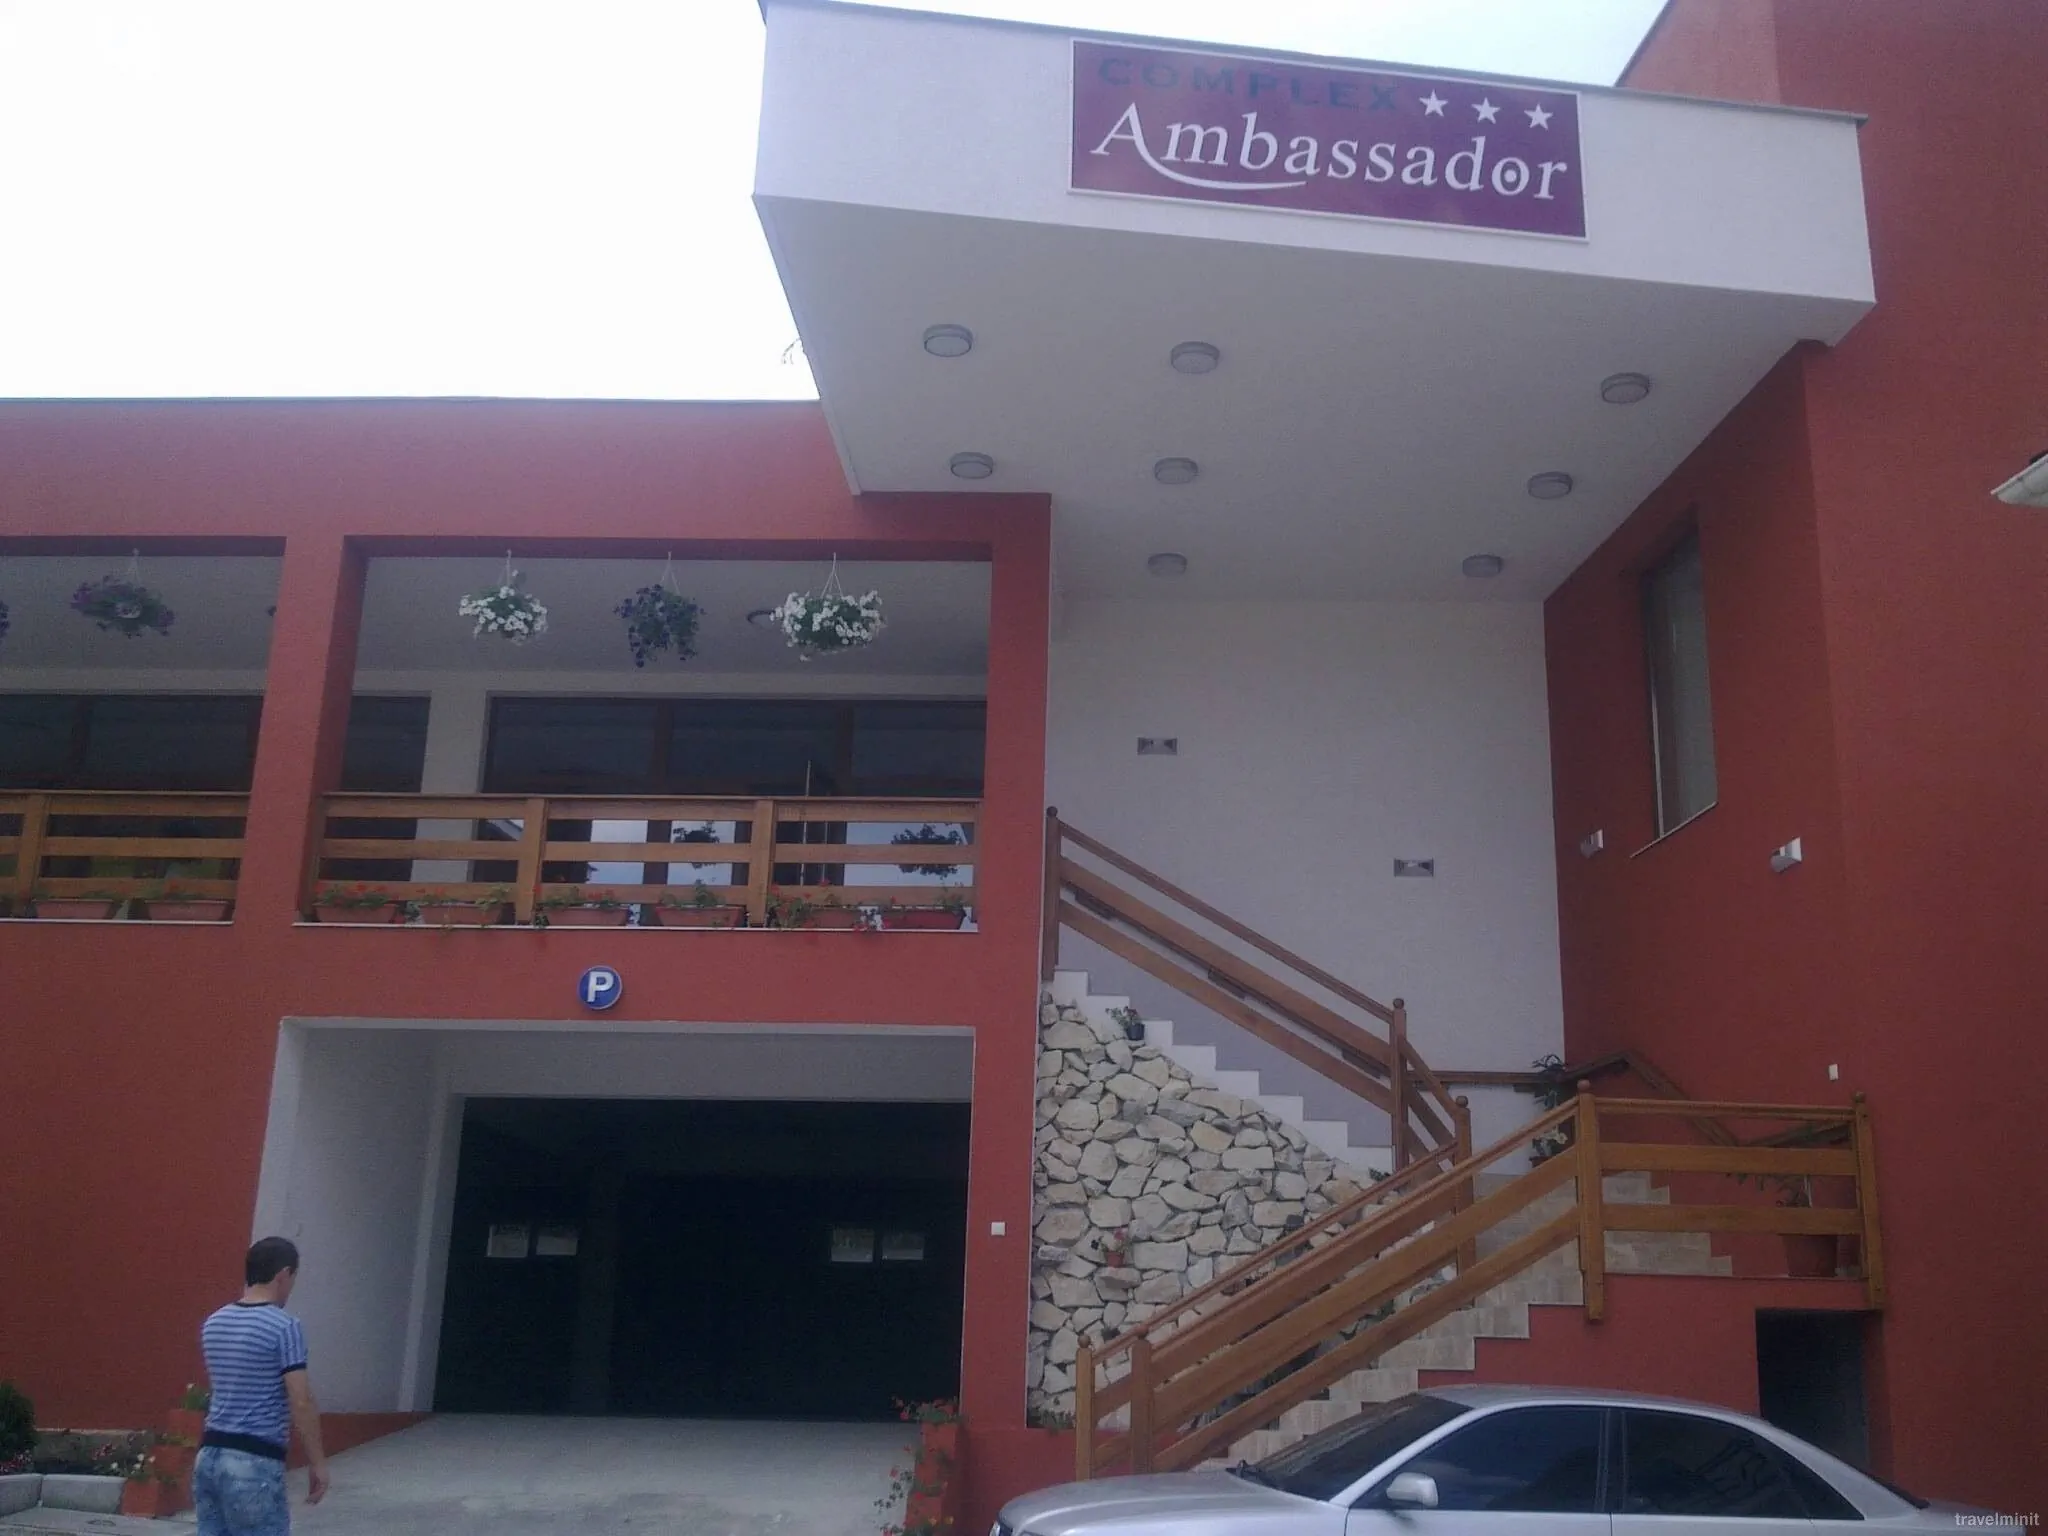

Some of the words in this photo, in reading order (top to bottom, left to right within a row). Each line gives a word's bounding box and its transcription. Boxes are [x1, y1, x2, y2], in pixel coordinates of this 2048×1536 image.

[1098, 57, 1398, 111] COMPLEX
[1090, 102, 1567, 200] Ambassador
[587, 971, 614, 1002] P
